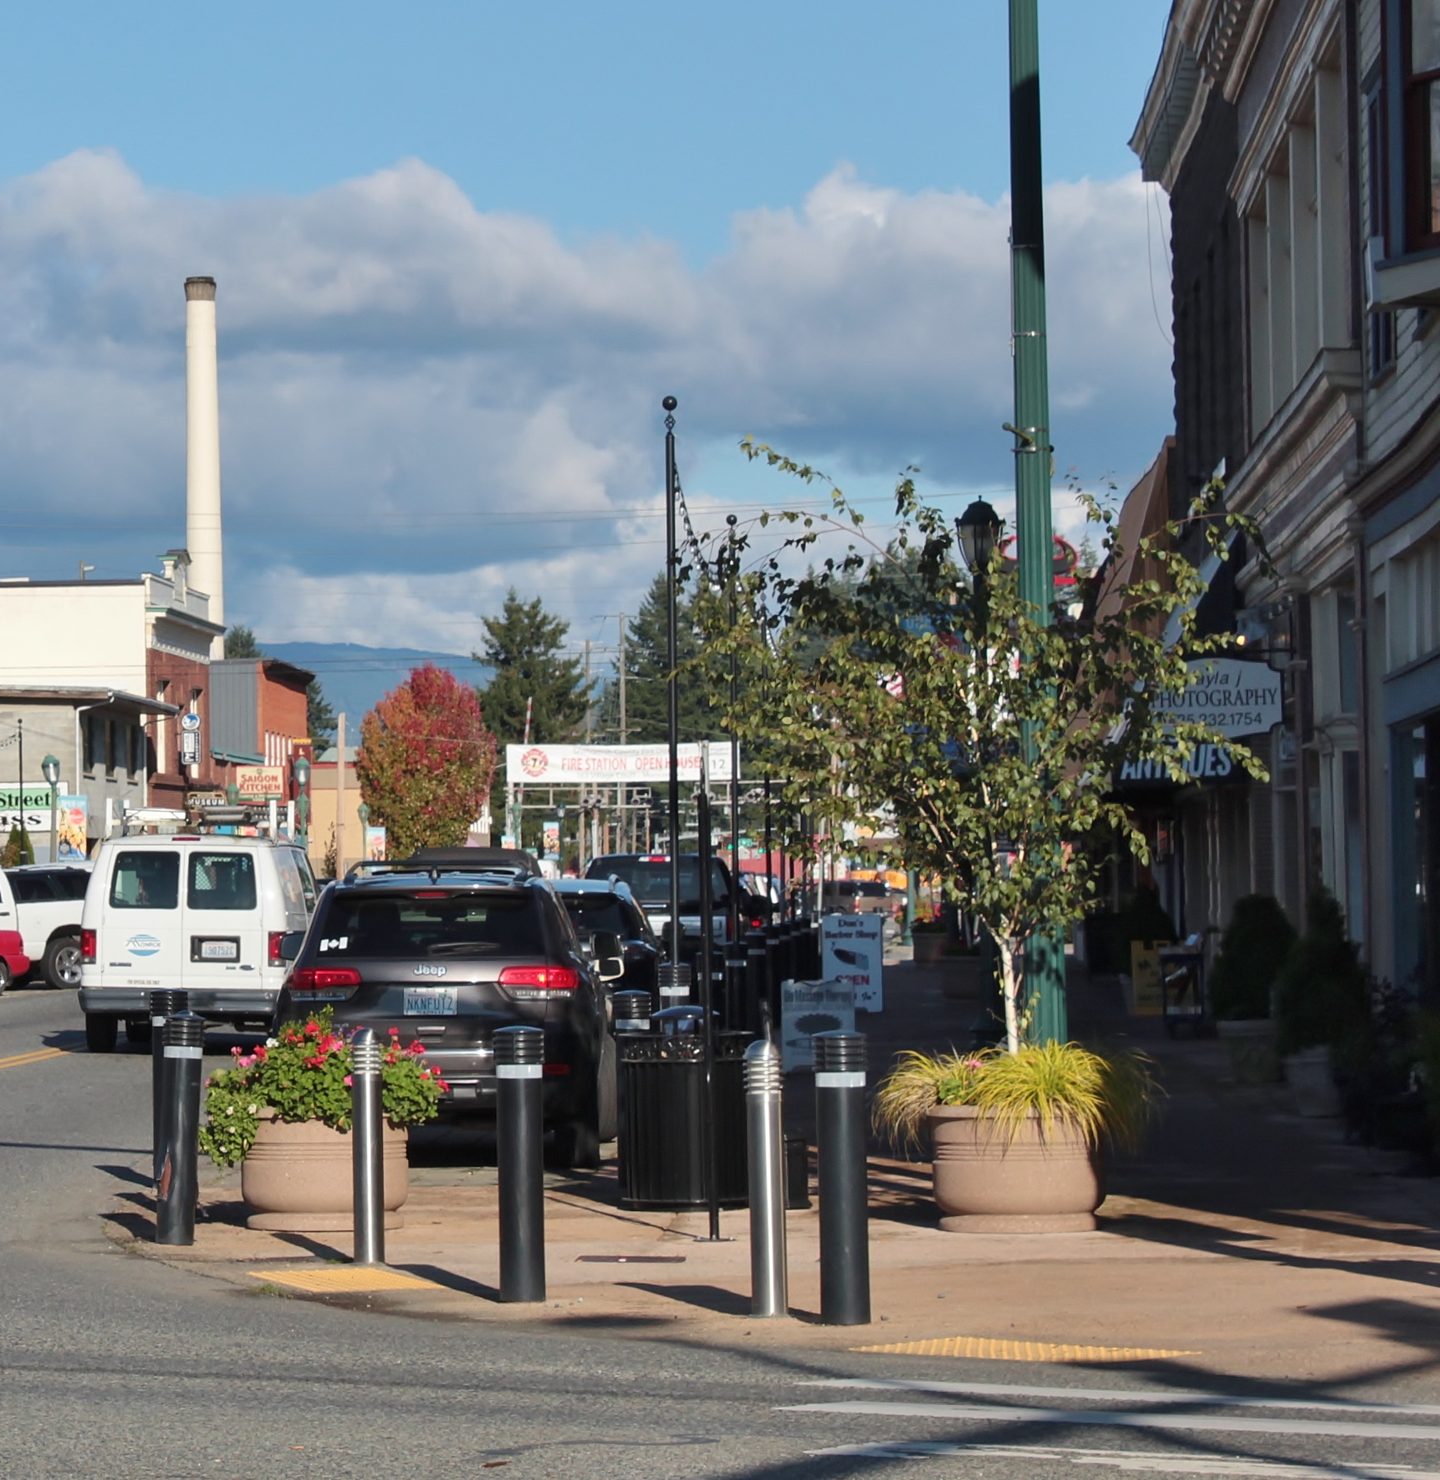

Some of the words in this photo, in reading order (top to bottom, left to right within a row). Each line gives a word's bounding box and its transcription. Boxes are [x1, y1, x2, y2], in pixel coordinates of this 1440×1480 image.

[1196, 671, 1229, 688] ayla
[1151, 688, 1278, 708] PHOTOGRAPHY
[561, 757, 583, 771] FIRE
[585, 757, 627, 770] STATION
[635, 756, 662, 770] OPEN
[665, 756, 700, 769] HUSE
[241, 774, 278, 783] SAIGON
[240, 784, 280, 792] KITCHEN
[187, 798, 225, 806] MUSEUM
[838, 919, 864, 927] Don's
[825, 931, 853, 939] Barber
[856, 931, 878, 940] Shop
[413, 964, 447, 977] Jeep
